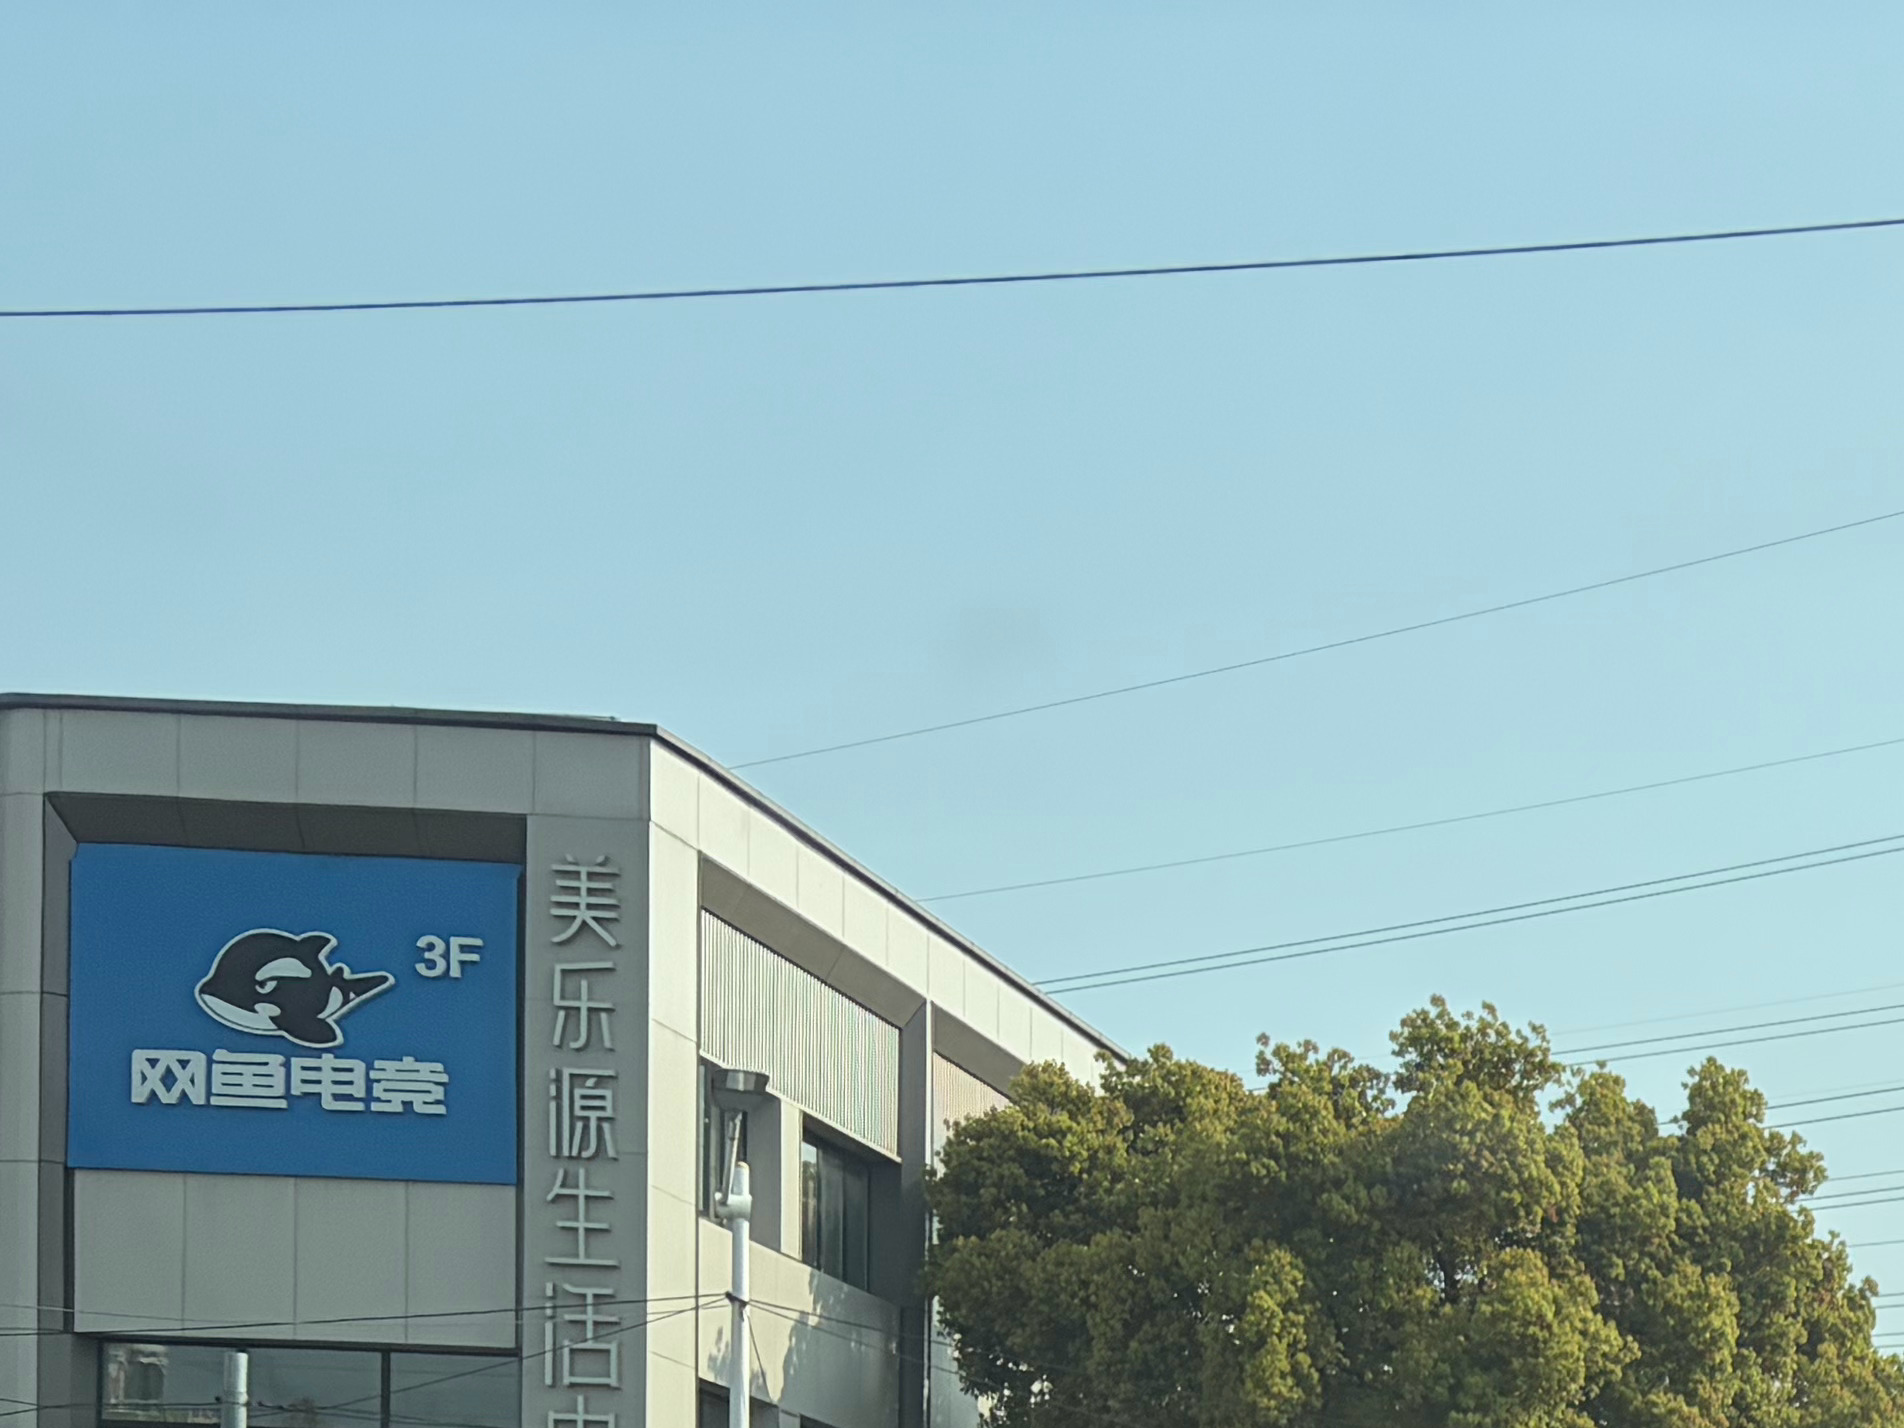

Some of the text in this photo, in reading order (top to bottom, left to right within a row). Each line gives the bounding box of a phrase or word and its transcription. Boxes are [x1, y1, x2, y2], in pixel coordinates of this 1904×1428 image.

[414, 935, 484, 979] 3F
[129, 1048, 449, 1116] 网鱼电竞
